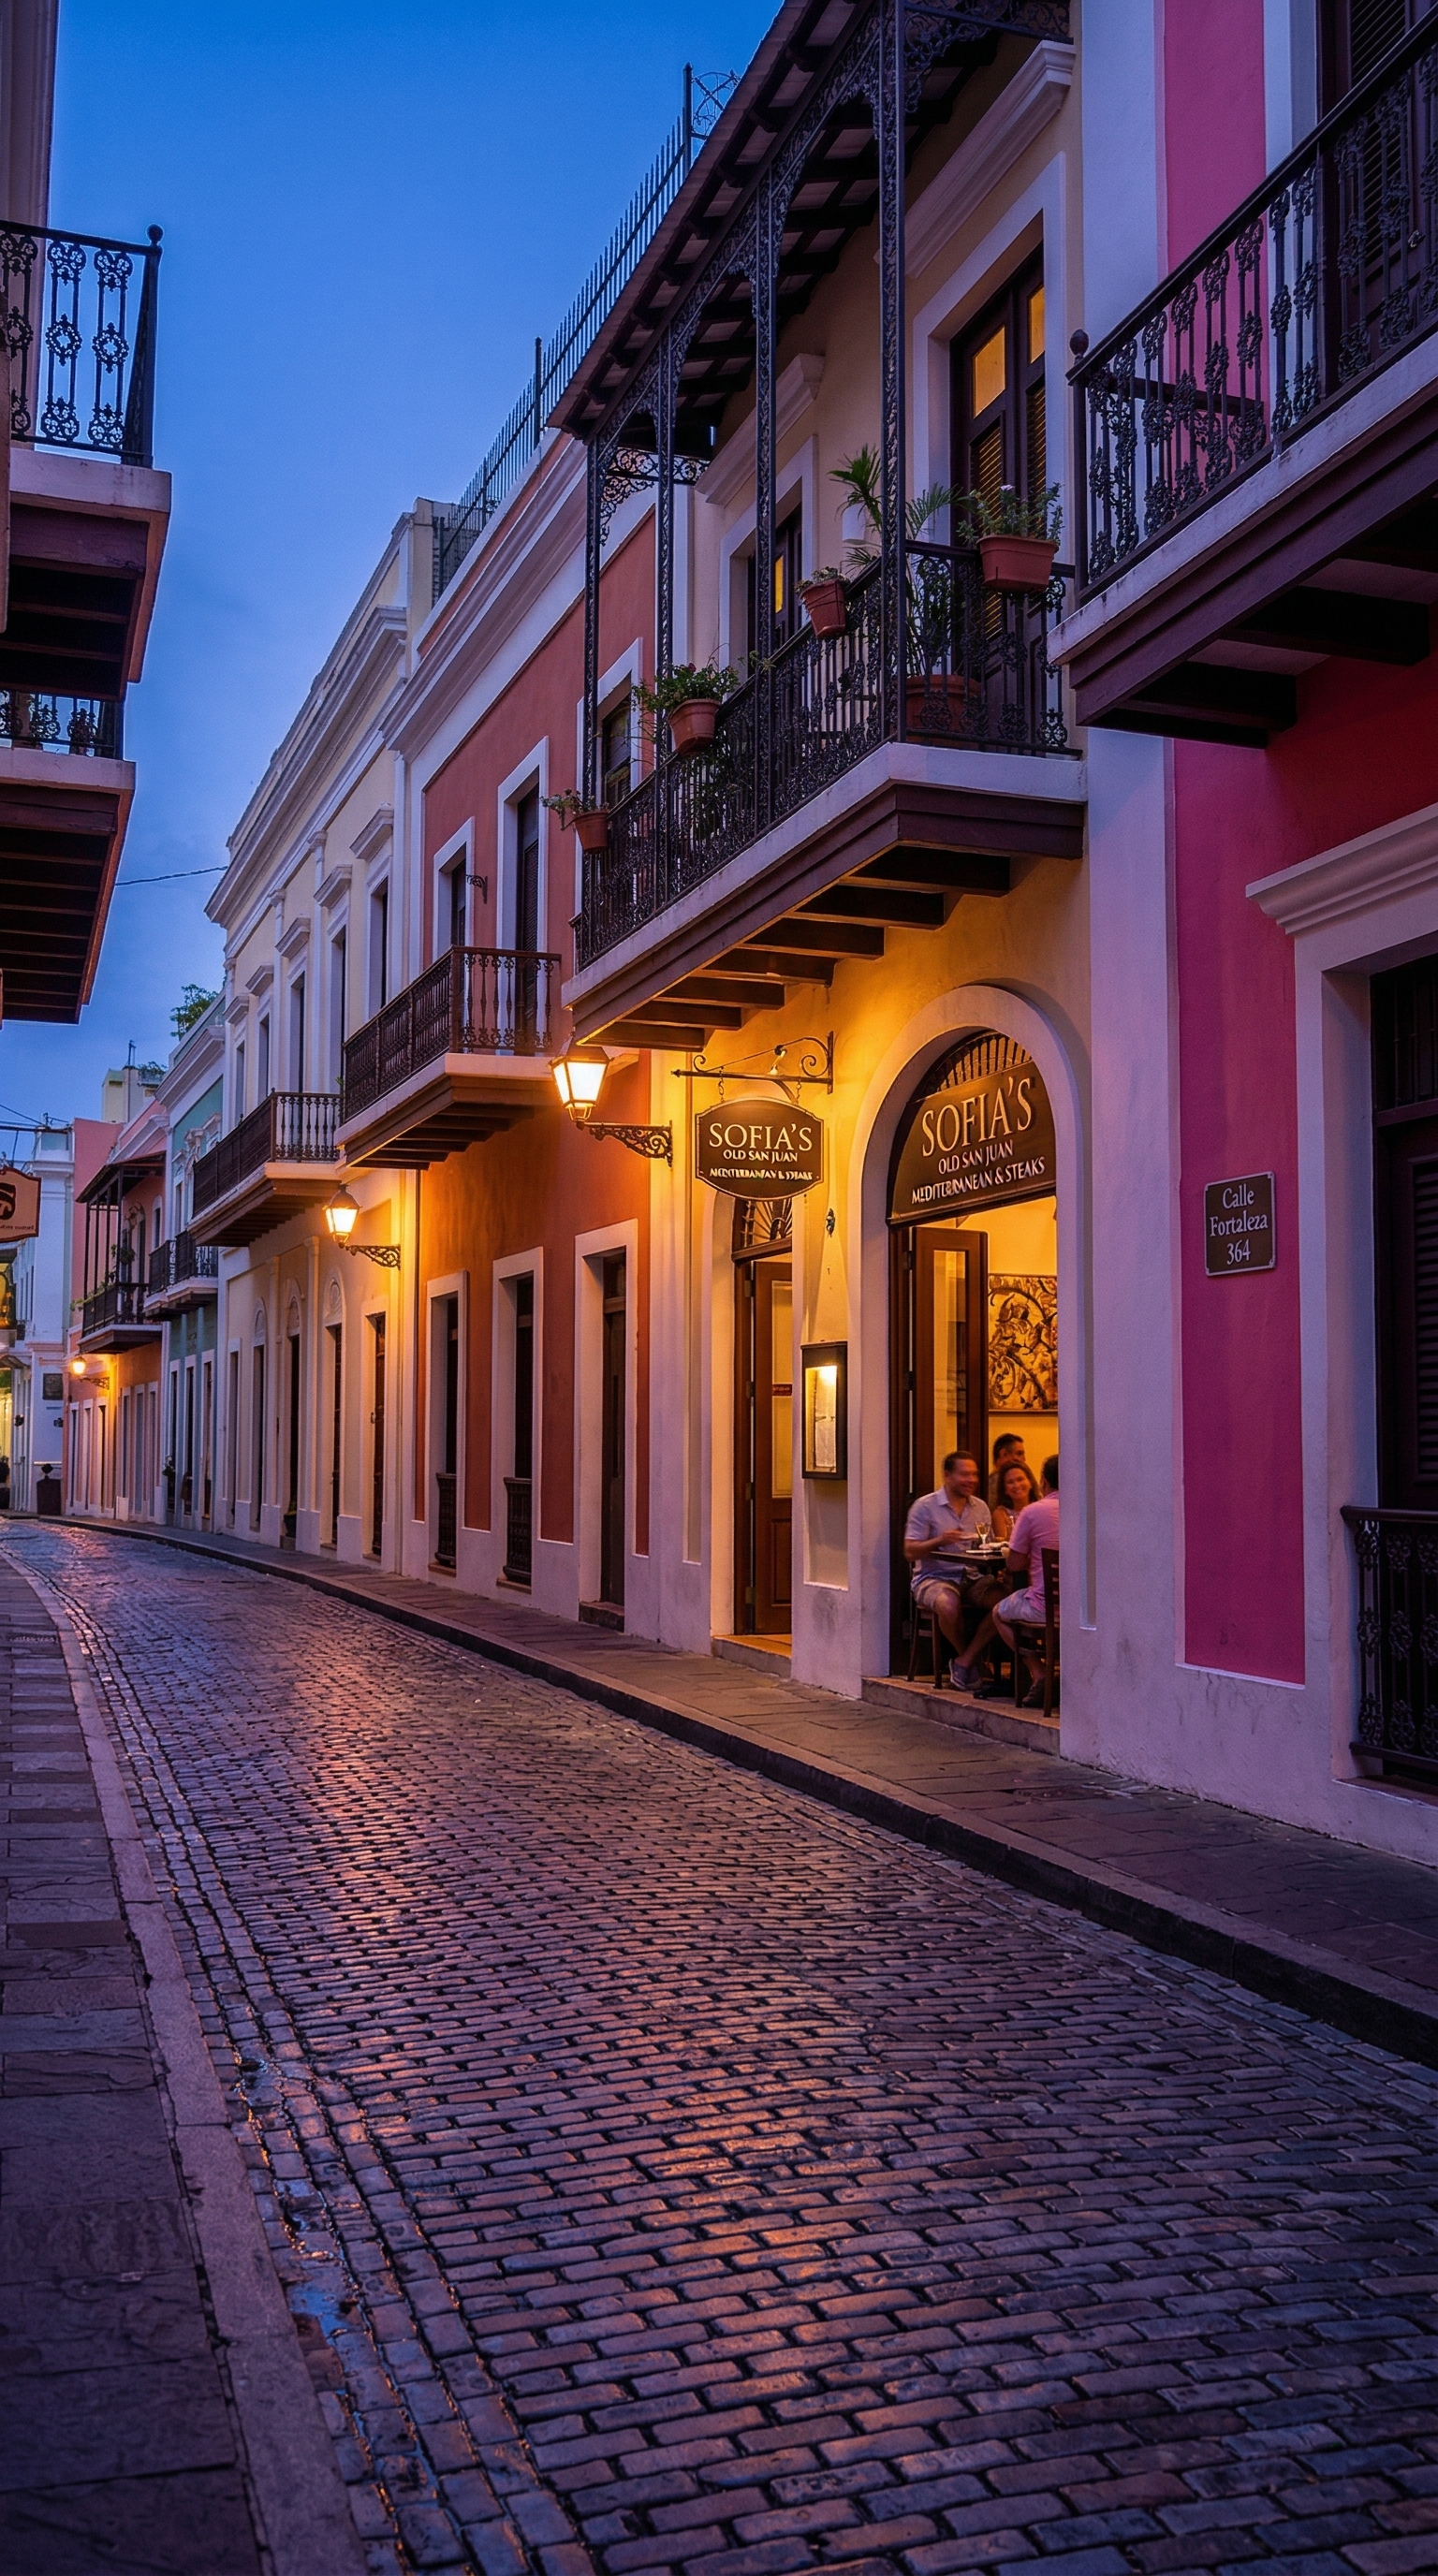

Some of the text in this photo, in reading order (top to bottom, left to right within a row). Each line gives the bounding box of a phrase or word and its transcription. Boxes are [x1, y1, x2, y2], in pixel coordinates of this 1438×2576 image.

[922, 1076, 1032, 1157] SOFIA'S
[709, 1122, 813, 1151] SOFIA'S
[723, 1149, 798, 1164] OLD SAN JUAN
[938, 1139, 1014, 1175] OLD SAN JUAN
[994, 1166, 1005, 1185] &
[1005, 1156, 1046, 1182] STEAKS
[1223, 1183, 1255, 1208] Calle
[1226, 1238, 1252, 1265] 364
